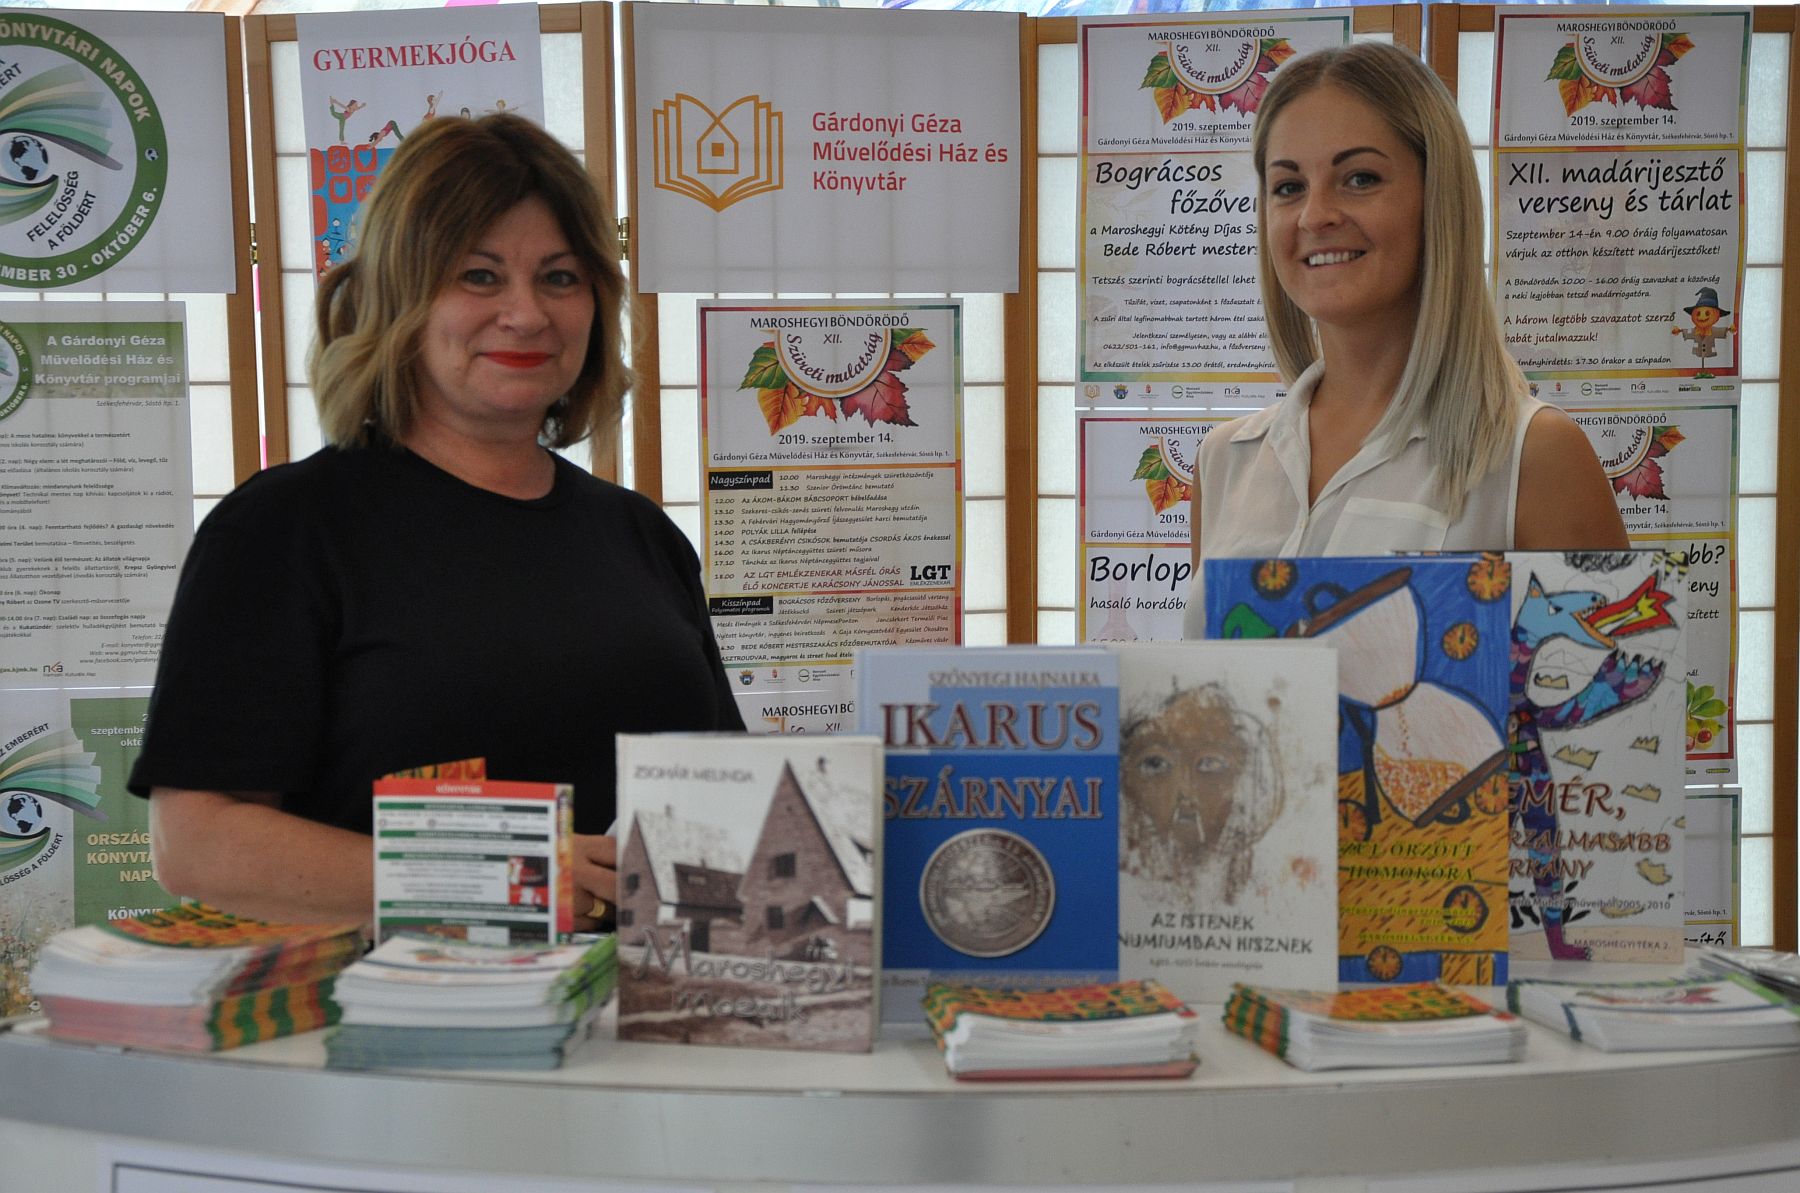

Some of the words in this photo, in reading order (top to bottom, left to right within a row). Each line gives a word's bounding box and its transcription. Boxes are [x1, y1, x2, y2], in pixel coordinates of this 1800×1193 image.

[1610, 36, 1624, 44] XII.
[313, 35, 516, 72] GYERMEKJÓGA
[1206, 43, 1220, 52] XII.
[1177, 44, 1206, 82] Szüreti
[1207, 41, 1253, 84] mulatság
[1584, 36, 1608, 74] Szüreti
[1610, 35, 1655, 77] mulatság
[100, 57, 150, 122] NAPOK
[812, 112, 904, 137] Gárdonyi
[912, 113, 961, 133] Géza
[1172, 122, 1197, 131] 2019.
[1199, 122, 1252, 134] szeptember
[1571, 116, 1598, 126] 2019.
[1601, 115, 1659, 128] szeptember
[1662, 115, 1676, 124] 14.
[1098, 137, 1130, 146] Gárdonyi
[1132, 137, 1150, 145] Géza
[1151, 136, 1193, 145] Művelődési
[1210, 136, 1218, 144] és
[1504, 133, 1537, 142] Gárdonyi
[1558, 132, 1600, 141] Művelődési
[1601, 132, 1615, 140] Ház
[1617, 132, 1624, 140] és
[1626, 132, 1660, 141] Könyvtár,
[813, 140, 931, 162] Művelődési
[940, 143, 977, 162] Ház
[985, 143, 1008, 163] és
[1096, 159, 1222, 190] Bográcsos
[1509, 162, 1550, 186] XII.
[1562, 157, 1726, 190] madárijesztő
[813, 170, 906, 195] Könyvtár
[1519, 195, 1613, 219] verseny
[1625, 188, 1648, 212] és
[1658, 187, 1732, 212] tárlat
[47, 239, 59, 250] A
[56, 190, 96, 242] FÖLDÉRT
[56, 264, 77, 278] 30
[91, 207, 150, 265] OKTÓBER
[142, 188, 158, 202] 6.
[1102, 224, 1165, 238] Maroshegyi
[1170, 224, 1209, 237] Kötény
[1214, 224, 1241, 237] Díjas
[1506, 229, 1566, 242] Szeptember
[1569, 229, 1601, 238] 14-én
[1606, 229, 1629, 238] 9.00
[1633, 228, 1658, 239] óráig
[1661, 226, 1728, 239] folyamatosan
[1104, 243, 1139, 256] Bede
[1146, 243, 1196, 256] Róbert
[1506, 248, 1537, 261] várjuk
[1541, 250, 1552, 258] az
[1556, 248, 1589, 258] otthon
[1592, 247, 1634, 258] készített
[1638, 246, 1720, 258] madárijesztőket!
[1092, 276, 1125, 285] Tetszés
[1128, 276, 1163, 284] szerinti
[1167, 275, 1229, 286] bográcsétellel
[1232, 276, 1256, 284] lehet
[1621, 276, 1639, 285] óráig
[1642, 275, 1678, 284] szavazhat
[1687, 274, 1720, 285] közönség
[1504, 316, 1511, 325] A
[1516, 314, 1548, 325] három
[1552, 313, 1587, 327] legtöbb
[1591, 314, 1641, 324] szavazatot
[1645, 312, 1676, 322] szerző
[47, 336, 57, 346] A
[62, 334, 125, 348] Gárdonyi
[130, 334, 165, 346] Géza
[824, 334, 842, 344] XII.
[1504, 332, 1532, 343] babát
[1535, 332, 1598, 345] jutalmazzuk!
[40, 354, 122, 365] Művelődési
[127, 354, 152, 365] Ház
[157, 354, 173, 365] és
[786, 333, 824, 382] Szüreti
[825, 331, 883, 384] mulatság
[1576, 357, 1598, 365] 17.30
[1601, 356, 1626, 365] órakor
[1635, 356, 1671, 366] színpadon
[35, 373, 100, 387] Könyvtár
[104, 373, 180, 386] programjai
[779, 434, 809, 445] 2019.
[811, 433, 875, 448] szeptember
[879, 433, 894, 443] 14.
[713, 452, 748, 463] Gárdonyi
[750, 452, 767, 460] Géza
[769, 450, 812, 461] Művelődési
[814, 451, 828, 459] Ház
[830, 450, 838, 459] és
[839, 450, 875, 460] Könyvtár,
[710, 474, 771, 486] Nagyszínpad
[1159, 514, 1188, 524] 2019.
[1091, 530, 1125, 540] Gárdonyi
[1146, 529, 1189, 538] Művelődési
[845, 567, 876, 576] MÁSFÉL
[879, 566, 900, 575] ÓRÁS
[910, 565, 951, 581] LGT
[1090, 553, 1191, 591] Borlop
[761, 581, 809, 590] KONCERTJE
[812, 579, 861, 589] KARÁCSONY
[863, 577, 904, 587] JÁNOSSAL
[1090, 596, 1131, 609] hasaló
[762, 705, 839, 717] MAROSHEGYI
[91, 726, 145, 736] szeptembe
[881, 701, 1102, 750] IKARUS
[884, 764, 1103, 820] SZÁRNYAI
[87, 829, 152, 846] ORSZÁG
[1151, 912, 1176, 928] AZ
[633, 926, 854, 992] Maroshegyi
